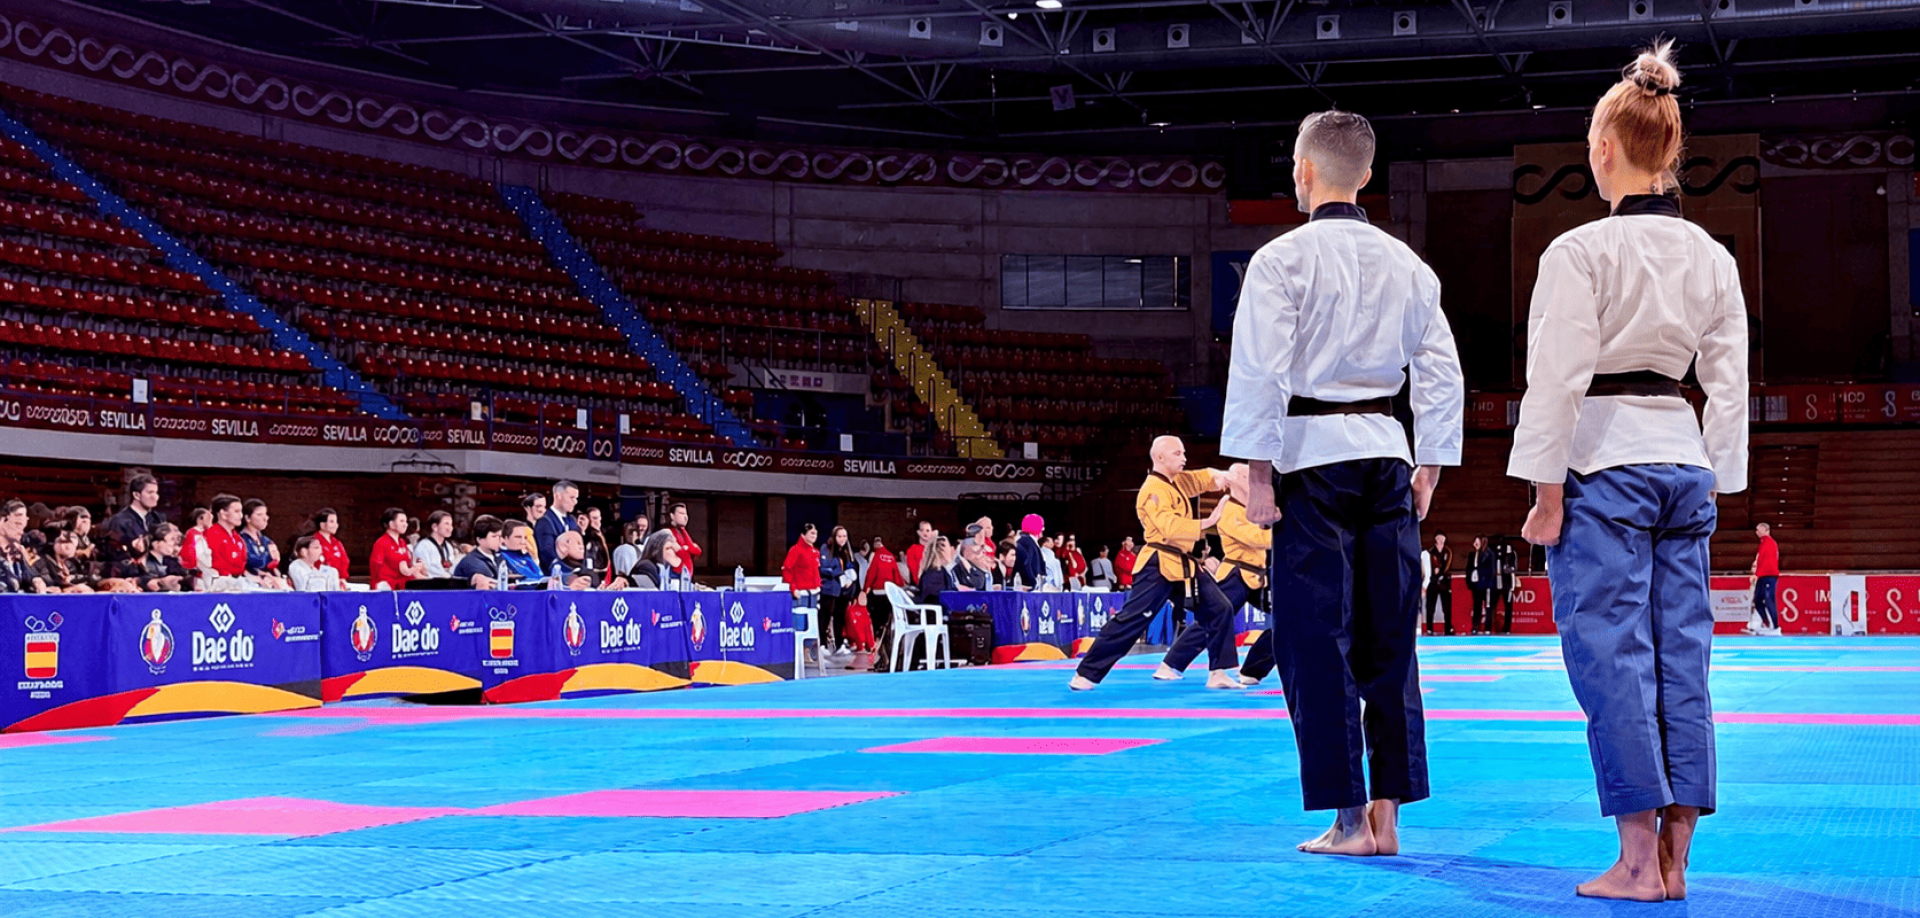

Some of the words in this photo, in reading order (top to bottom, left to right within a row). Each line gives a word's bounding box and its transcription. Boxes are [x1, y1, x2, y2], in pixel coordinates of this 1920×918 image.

[100, 410, 146, 430] SEVILLA
[212, 419, 259, 436] SEVILLA
[323, 425, 367, 441] SEVILLA
[448, 429, 485, 444] SEVILLA
[669, 448, 714, 464] SEVILLA
[844, 459, 897, 474] SEVILLA
[392, 623, 419, 653] Dae
[421, 622, 439, 650] do
[600, 621, 624, 648] Dae
[625, 617, 641, 645] do
[720, 621, 740, 647] Dae
[741, 621, 755, 647] do
[192, 631, 227, 665] Dae
[229, 629, 254, 662] do
